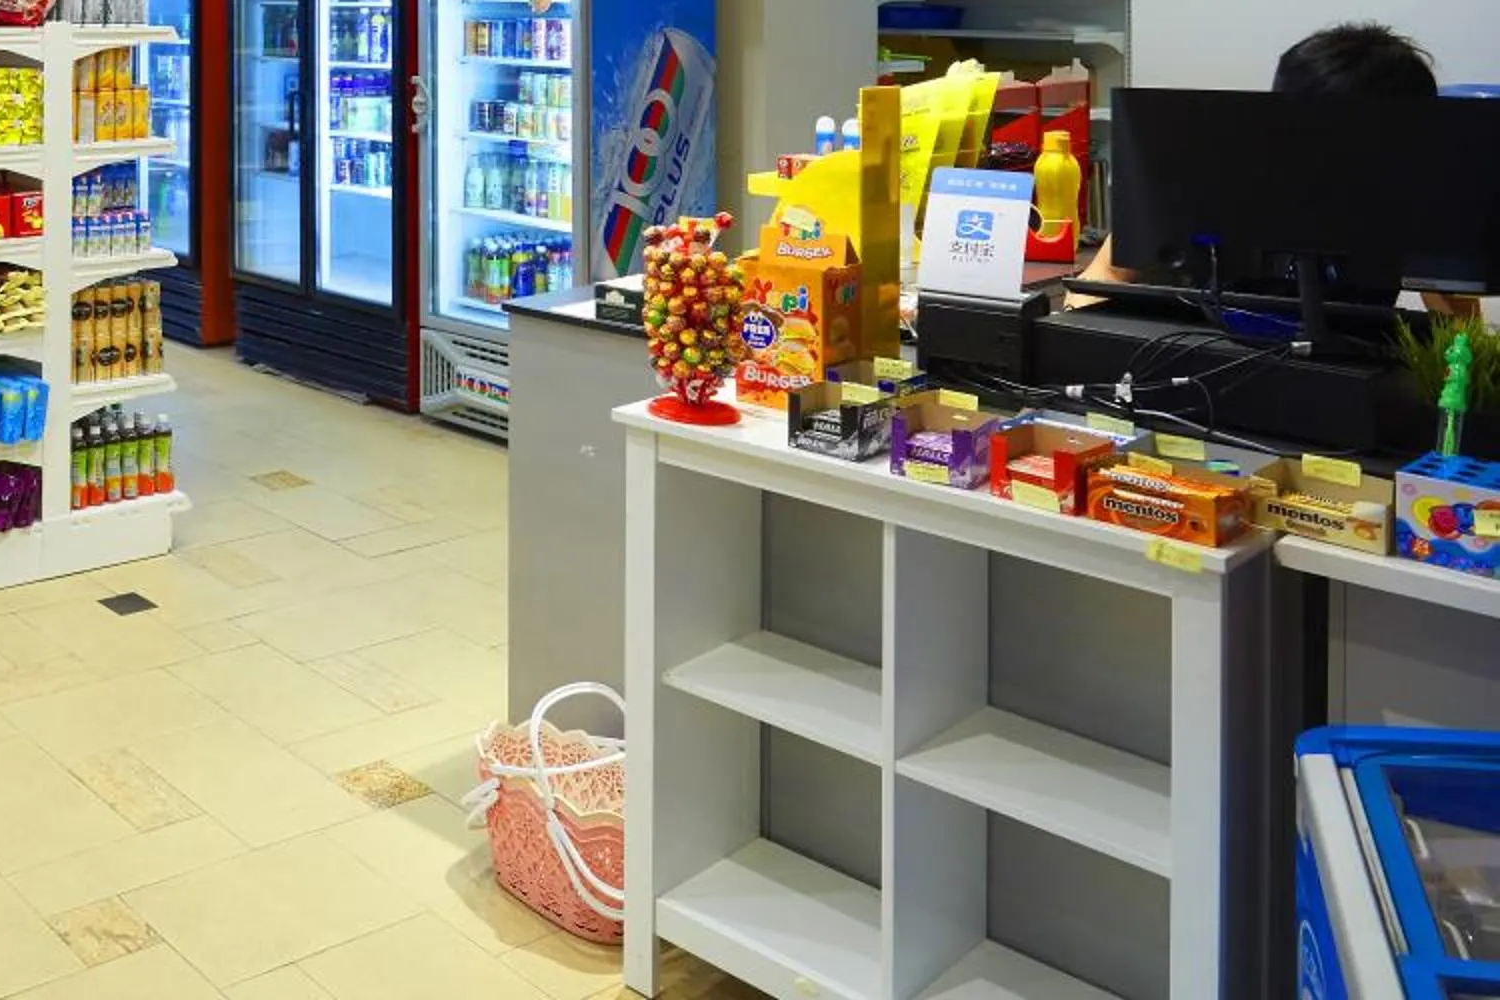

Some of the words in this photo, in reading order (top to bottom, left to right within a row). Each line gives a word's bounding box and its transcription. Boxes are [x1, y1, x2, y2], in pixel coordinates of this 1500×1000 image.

[653, 133, 691, 226] PLUS
[744, 363, 814, 389] BURGER
[1103, 497, 1180, 524] mentos
[1267, 502, 1345, 531] mentos
